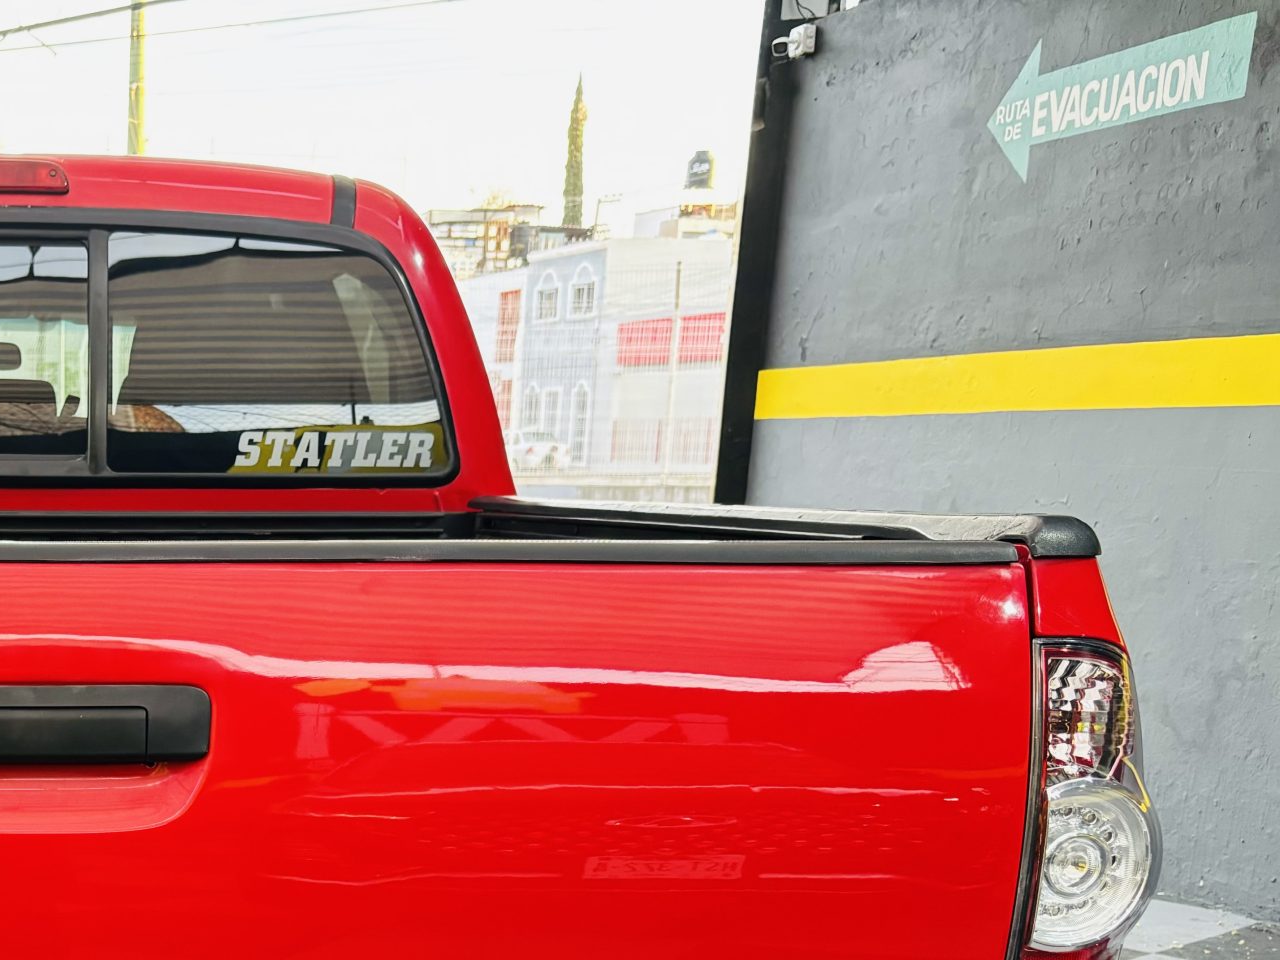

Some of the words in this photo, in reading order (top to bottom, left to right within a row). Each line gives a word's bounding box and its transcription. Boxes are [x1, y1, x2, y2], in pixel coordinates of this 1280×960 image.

[1031, 50, 1210, 138] EVACUACION
[995, 97, 1031, 126] RUTA
[1004, 122, 1023, 143] DE
[233, 430, 435, 468] STATLER
